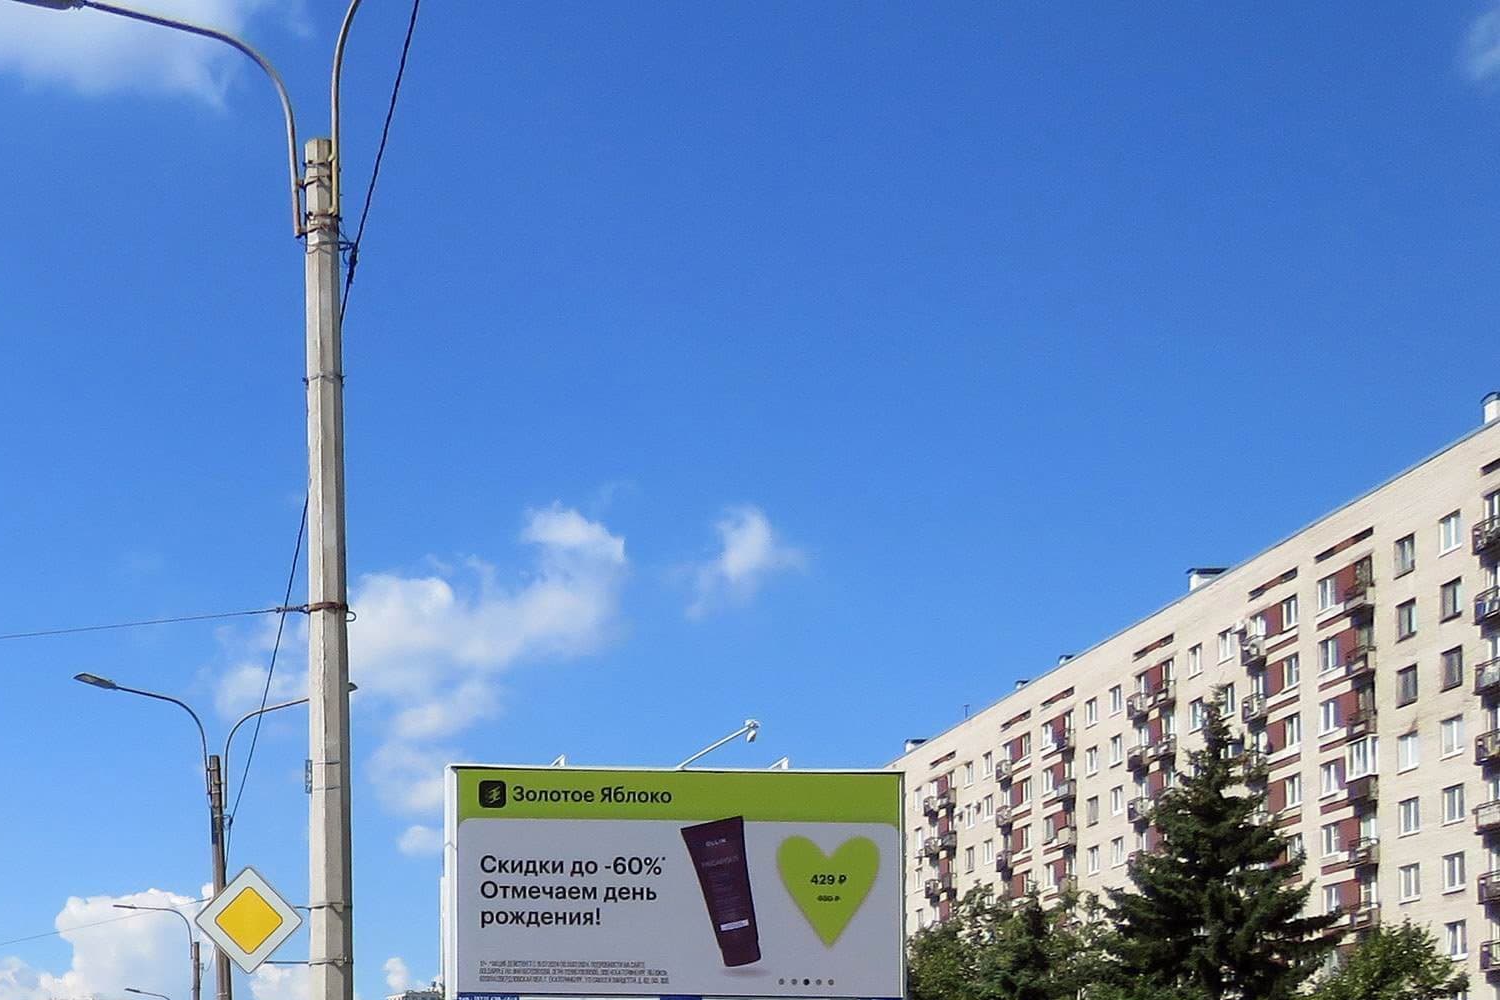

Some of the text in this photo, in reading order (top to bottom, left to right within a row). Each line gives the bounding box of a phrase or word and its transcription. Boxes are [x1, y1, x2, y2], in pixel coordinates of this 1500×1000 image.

[512, 785, 672, 804] Золотое Яблоко
[480, 855, 564, 877] Скидки
[570, 860, 598, 878] до
[810, 874, 835, 885] 429
[480, 880, 658, 903] Отмечаем день
[480, 908, 601, 929] рождения!
